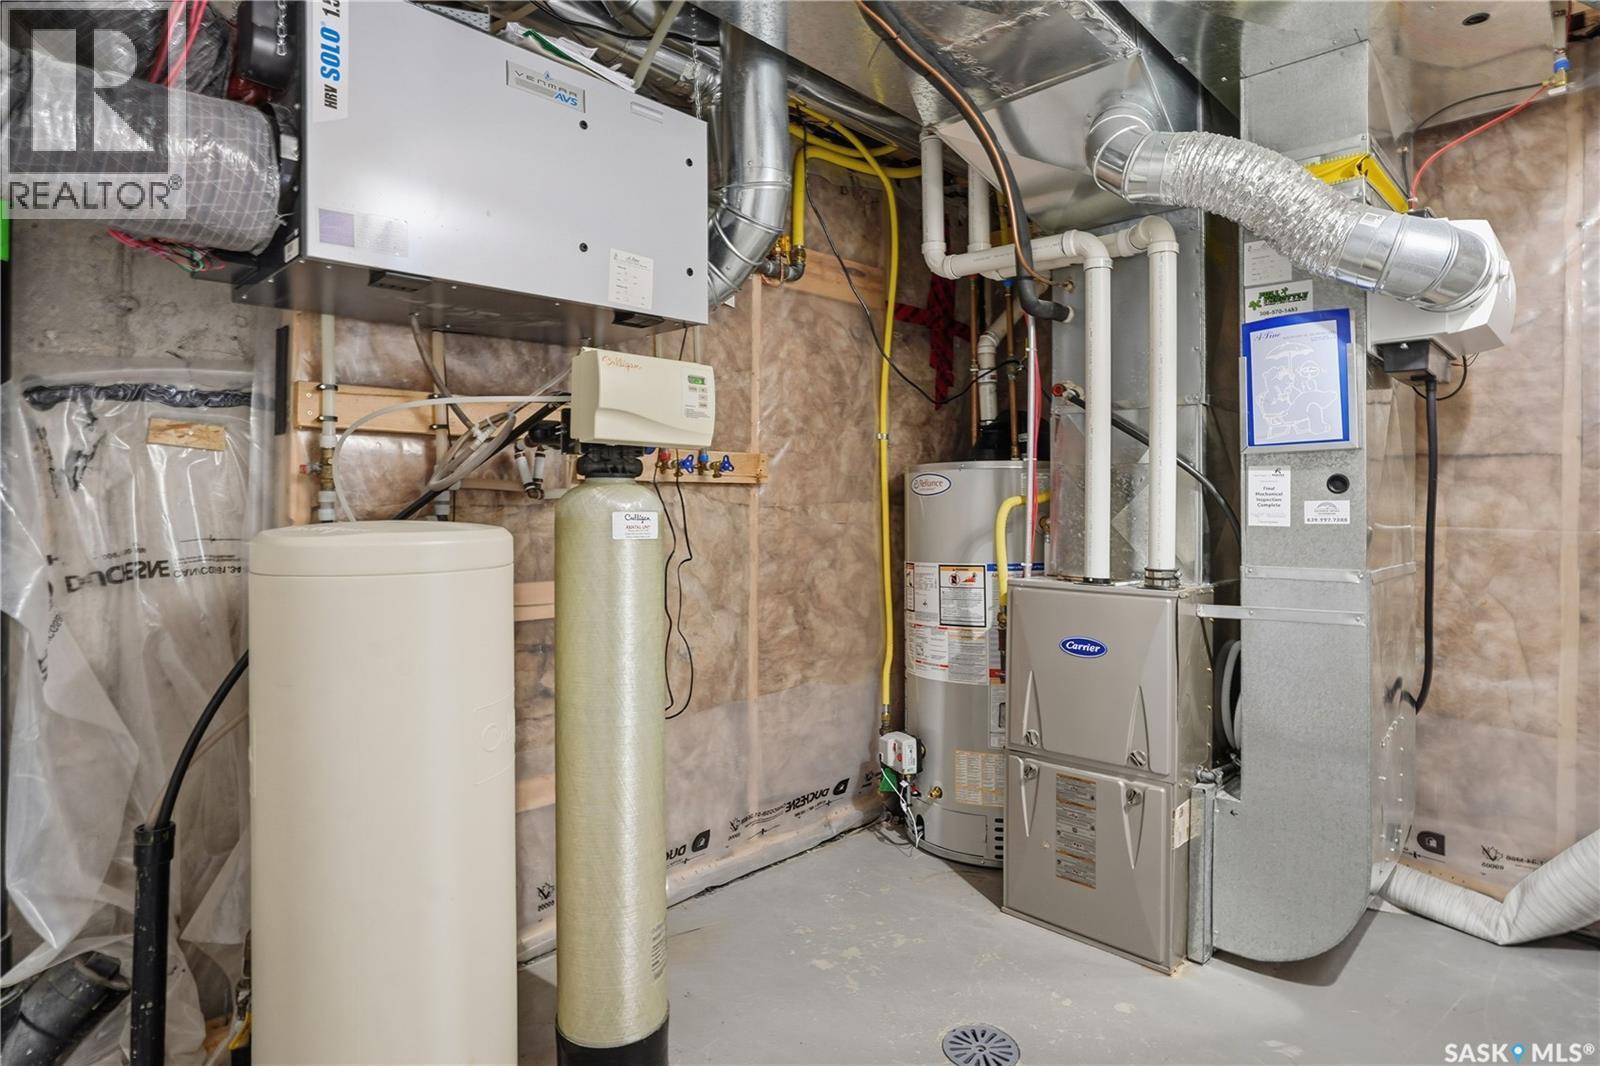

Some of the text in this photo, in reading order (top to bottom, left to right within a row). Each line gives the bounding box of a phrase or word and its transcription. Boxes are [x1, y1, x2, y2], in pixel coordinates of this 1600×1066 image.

[324, 84, 338, 110] HRV
[554, 92, 578, 107] AVS
[1065, 640, 1101, 653] Carrier
